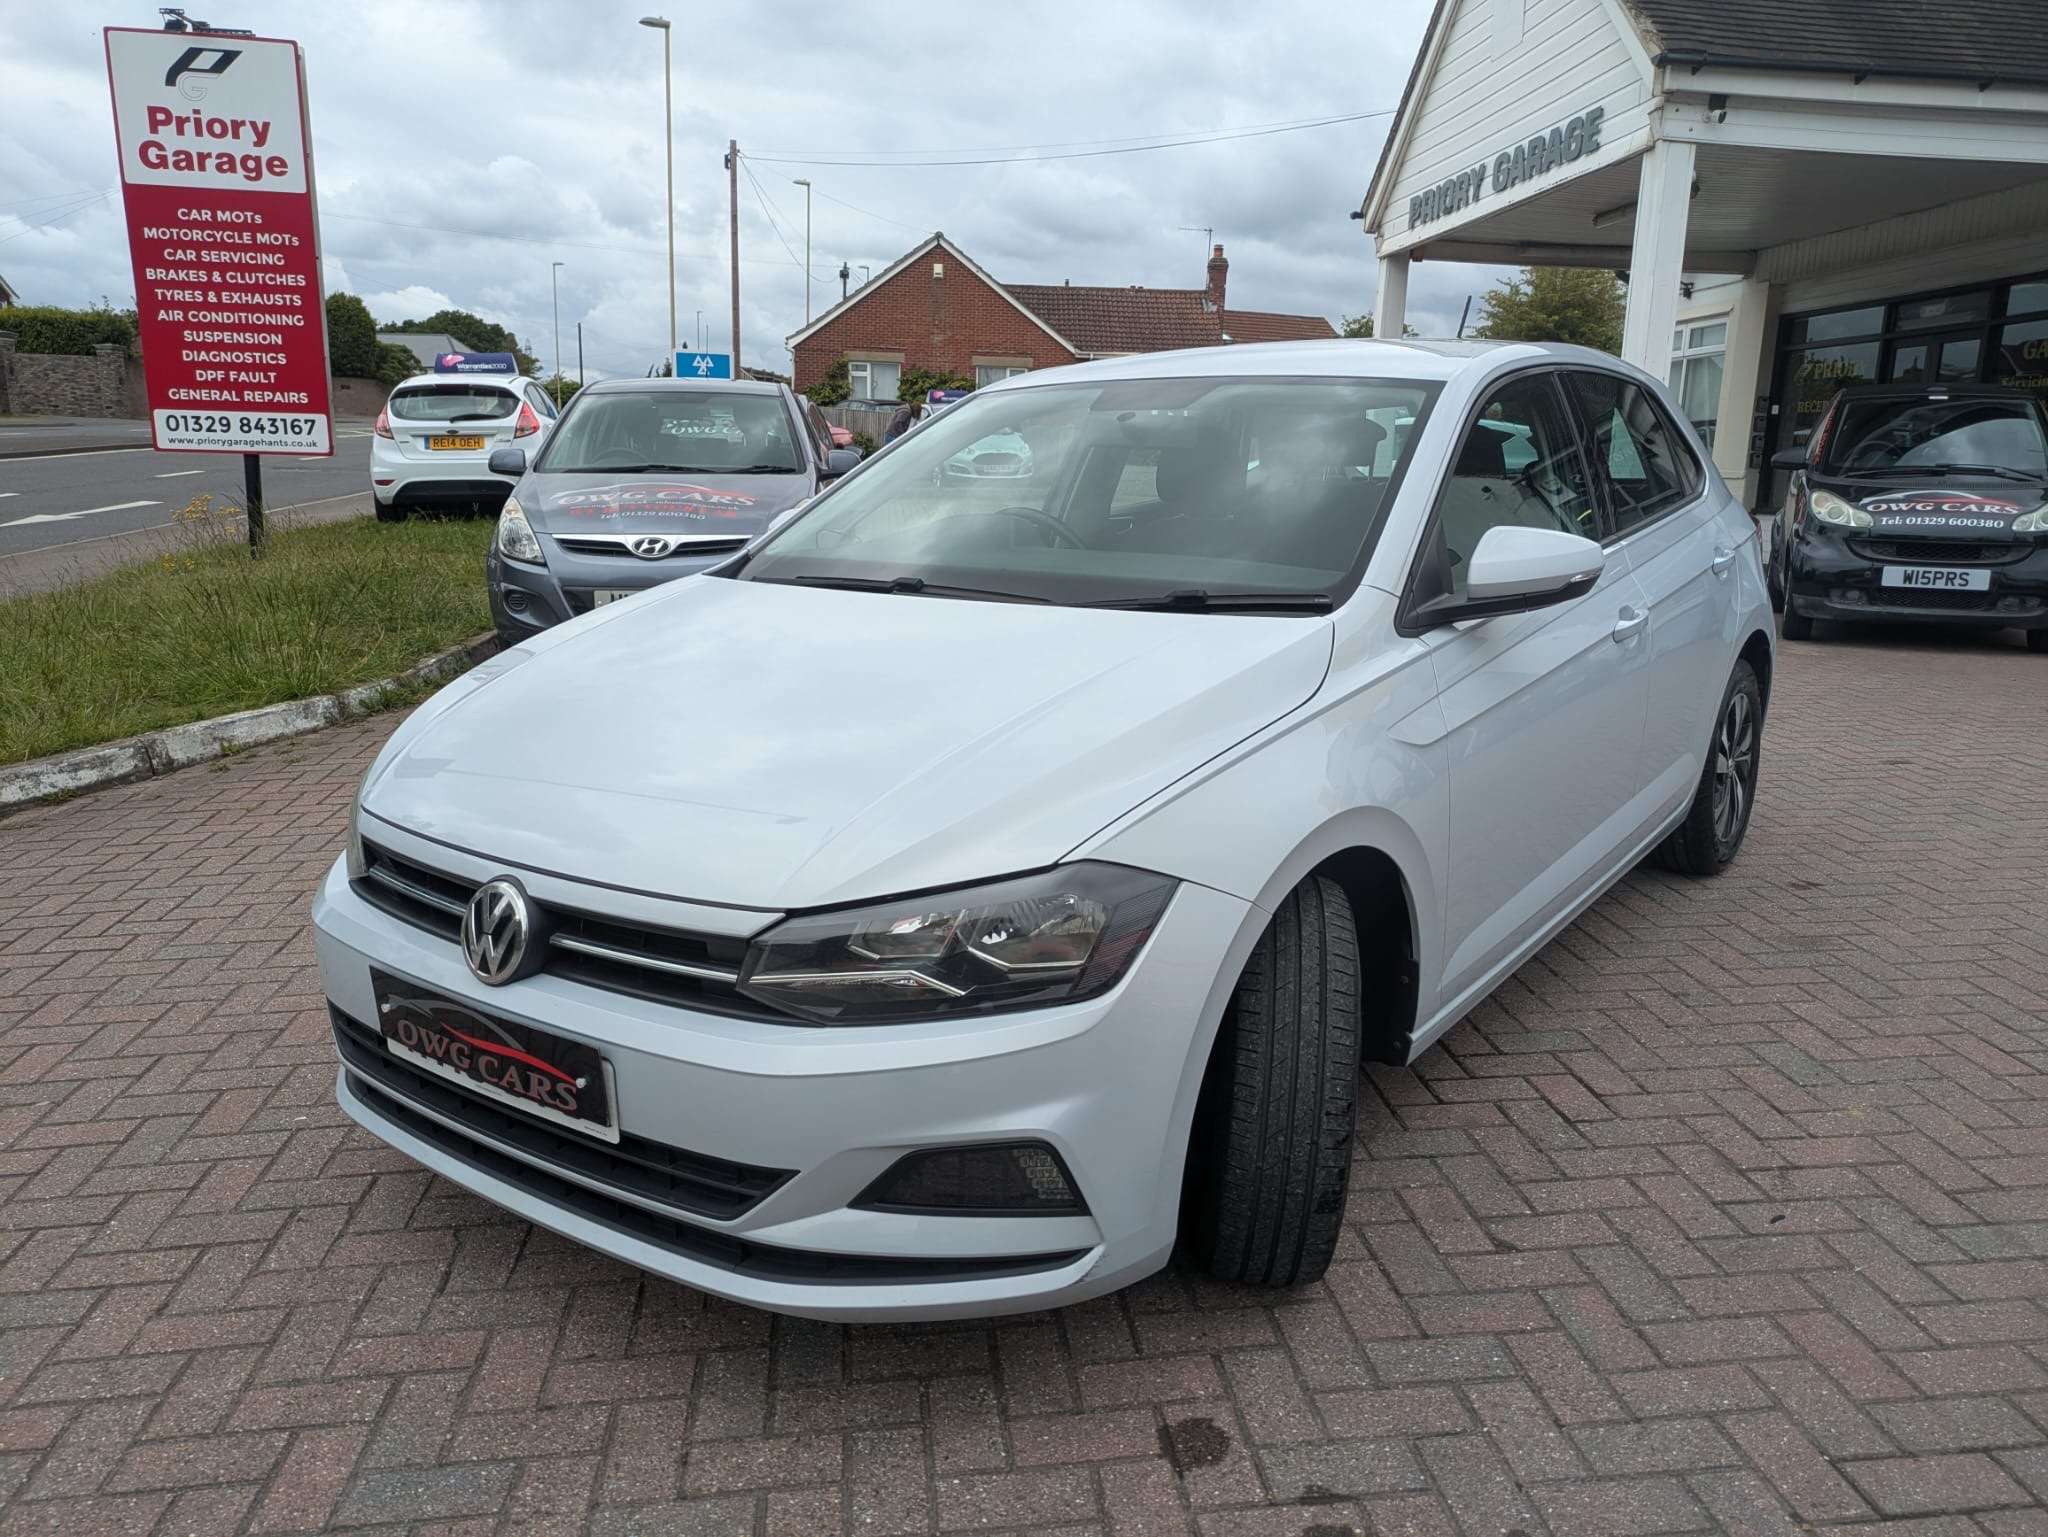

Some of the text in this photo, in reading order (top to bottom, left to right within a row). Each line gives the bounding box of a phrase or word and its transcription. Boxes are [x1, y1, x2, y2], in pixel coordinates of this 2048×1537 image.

[146, 106, 271, 147] Priory
[138, 141, 289, 181] Garage
[1408, 105, 1604, 229] PRIORY GARAGE
[177, 208, 263, 224] CAR MOTs
[143, 227, 300, 246] MOTORCYCLE MOTs
[164, 249, 285, 265] CAR SERVICING
[146, 269, 305, 286] BRAKES & CLUTCHES
[155, 289, 302, 306] TYRES & EXHAUSTS
[157, 310, 304, 326] AIR CONDITIONING
[184, 330, 283, 344] SUSPENSION
[182, 350, 287, 365] DIAGNOSTICS
[196, 370, 277, 384] DPF FAULT
[169, 388, 308, 404] GENERAL REPAIRS
[165, 415, 316, 436] 01329 843167
[167, 436, 319, 449] www.priorygaragehants.co.uk
[433, 438, 480, 448] RE14 OEH
[558, 491, 755, 506] OWG CARS
[1866, 502, 2019, 514] OWG CARS
[1880, 516, 2004, 529] Tel: 01329 600380
[397, 1019, 577, 1111] OWG CARS
